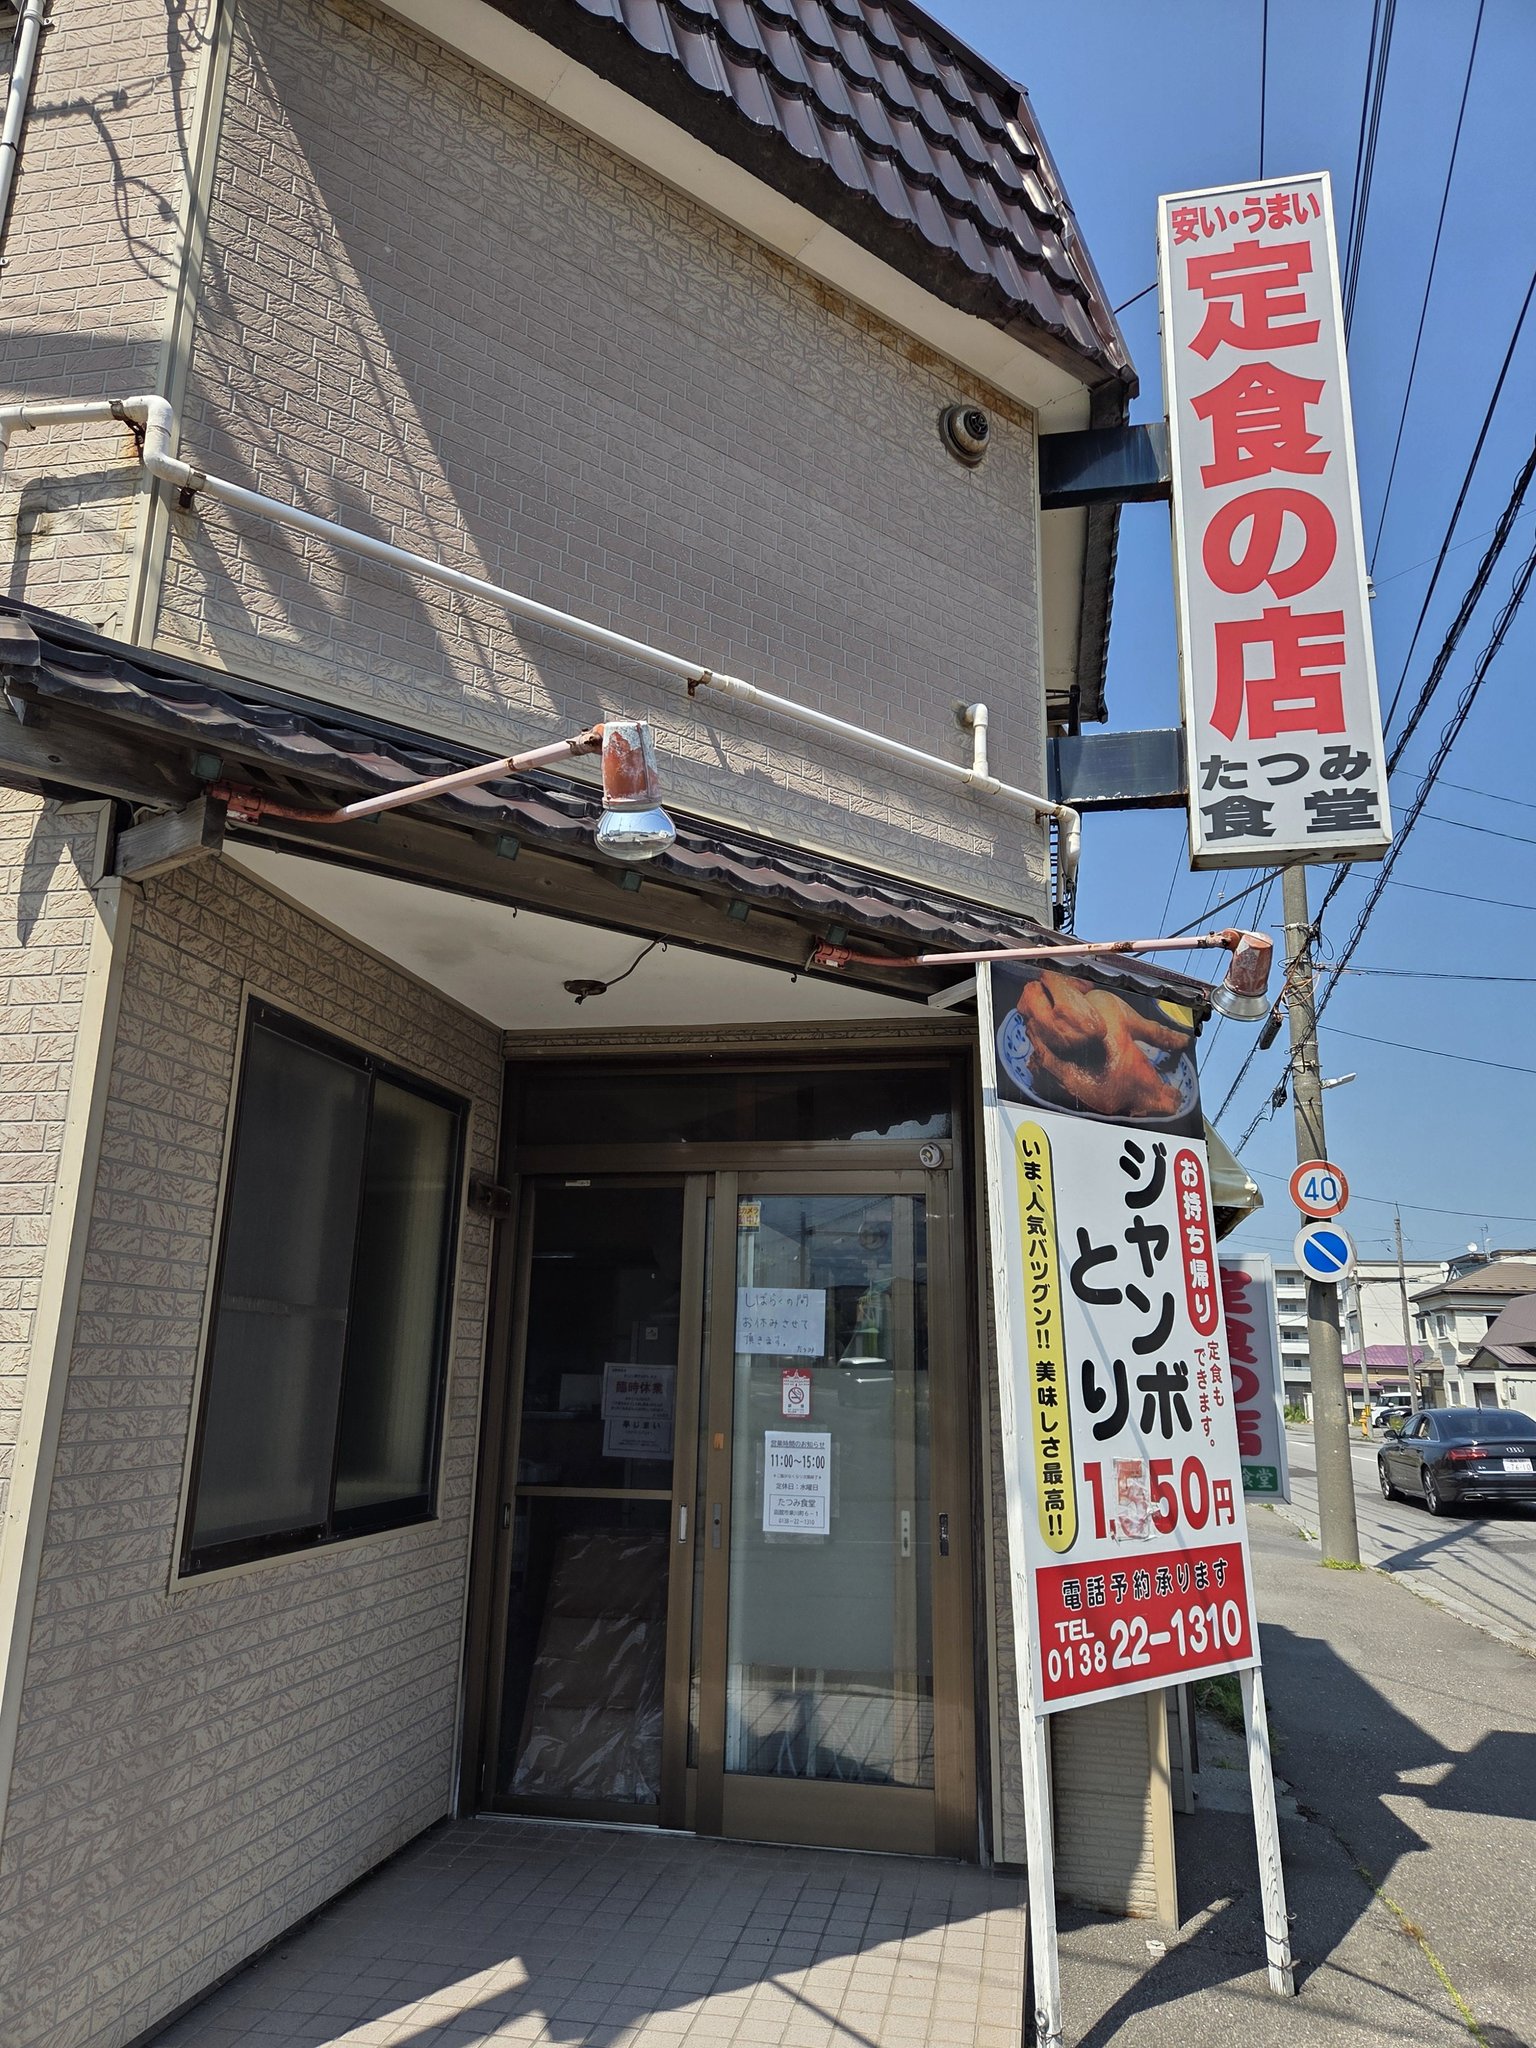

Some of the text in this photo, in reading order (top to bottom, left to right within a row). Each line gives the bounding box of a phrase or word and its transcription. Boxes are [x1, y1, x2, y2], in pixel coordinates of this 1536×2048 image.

[1171, 192, 1320, 246] 安い・うまい
[1187, 240, 1346, 742] 定食の店
[1200, 745, 1372, 791] たつみ
[1200, 788, 1382, 841] 食堂
[1304, 1176, 1337, 1201] 40
[1180, 1158, 1212, 1324] お持ち帰り
[742, 1316, 809, 1330] お休みさせて
[1070, 1227, 1130, 1442] とり
[1194, 1348, 1215, 1447] できます。
[1208, 1341, 1224, 1406] 定食も
[778, 1498, 816, 1508] たつみ食堂
[1062, 1557, 1229, 1611] 電話予約承ります
[1054, 1618, 1095, 1643] TEL
[1048, 1640, 1108, 1683] 0138
